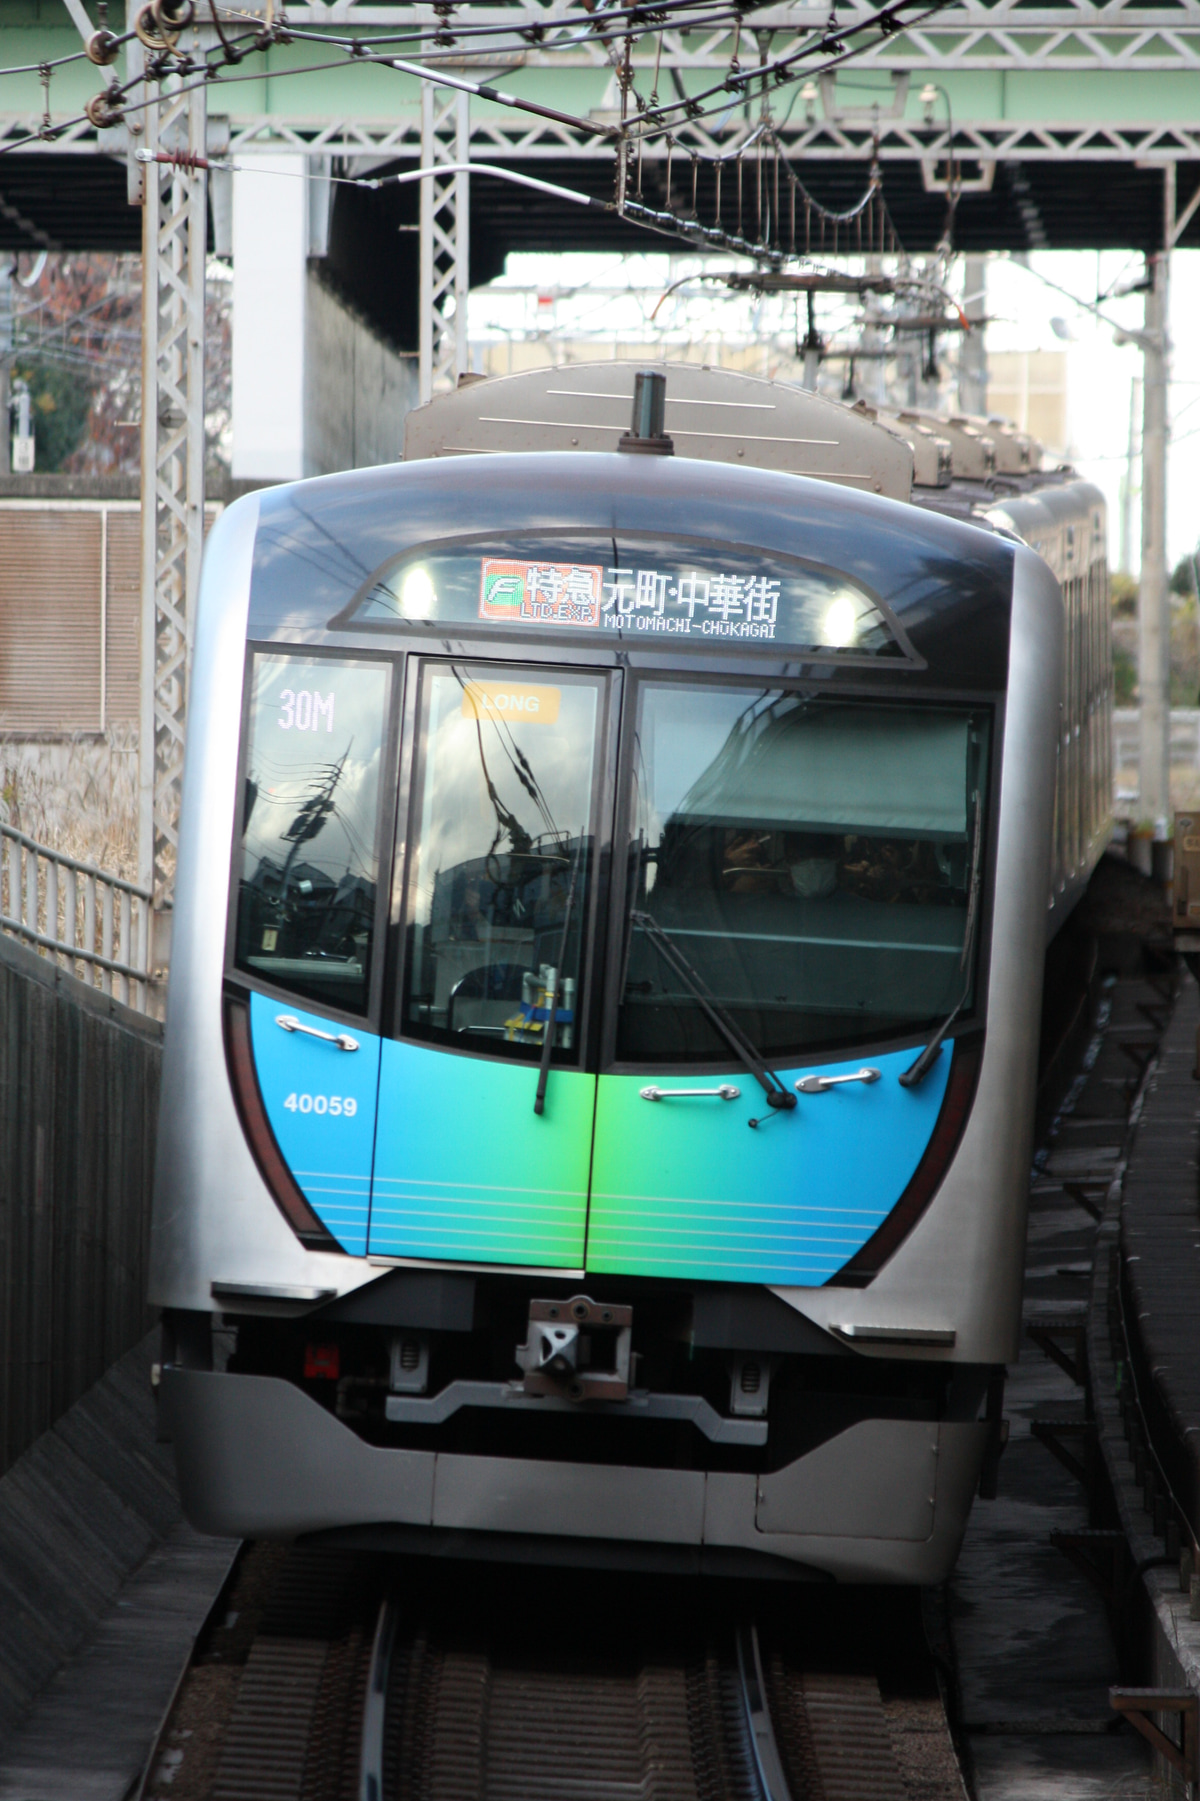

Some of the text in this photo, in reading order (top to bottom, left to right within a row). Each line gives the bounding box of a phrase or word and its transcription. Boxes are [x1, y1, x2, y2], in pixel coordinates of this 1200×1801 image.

[526, 565, 597, 606] 特急
[277, 688, 336, 733] 30M
[481, 693, 540, 713] LONG
[283, 1092, 358, 1118] 40059
